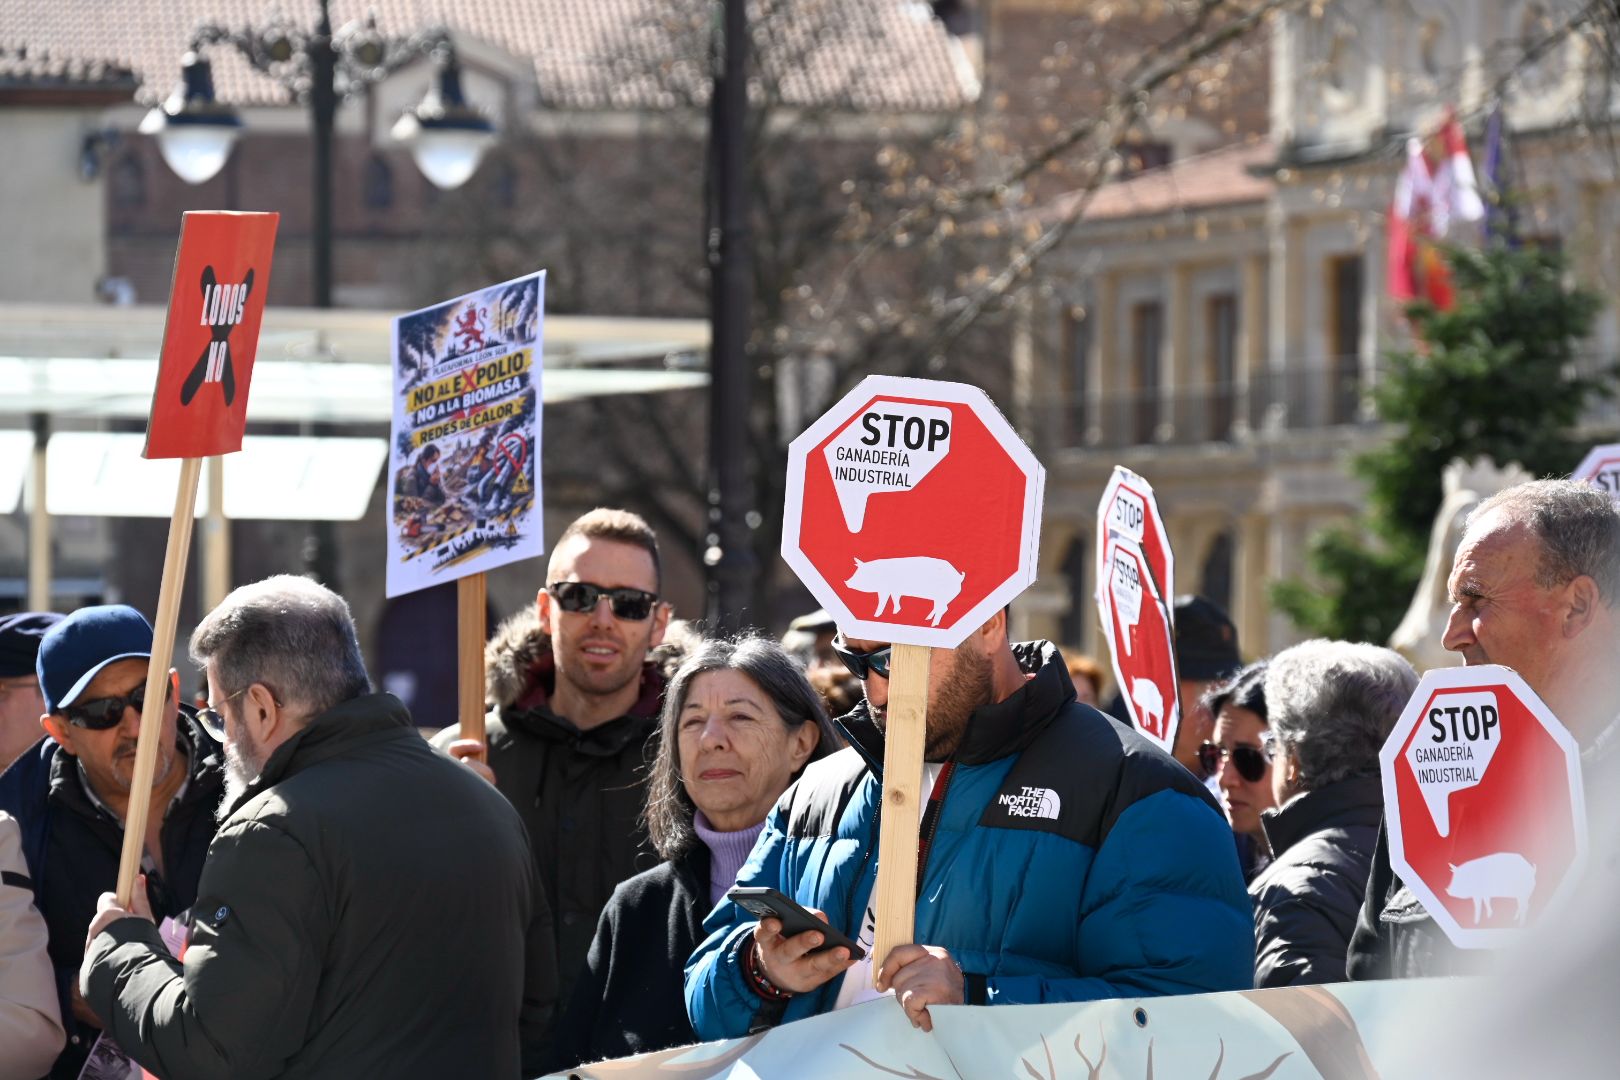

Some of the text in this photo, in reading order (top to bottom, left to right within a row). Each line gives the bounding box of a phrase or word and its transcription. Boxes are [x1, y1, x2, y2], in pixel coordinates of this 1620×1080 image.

[200, 283, 247, 326] LODOS
[204, 341, 227, 383] NO
[413, 352, 524, 407] NO AL EXPOLIO
[417, 376, 521, 424] NO A LA BIOMASA
[463, 408, 470, 418] Y
[420, 403, 513, 444] REDES DE CALOR
[860, 412, 950, 452] STOP
[836, 446, 910, 467] GANADERÍA
[835, 466, 912, 488] INDUSTRIAL
[1596, 471, 1620, 491] ST
[1116, 496, 1143, 531] STOP
[1115, 558, 1139, 592] STOP
[1429, 705, 1498, 743] STOP
[1416, 743, 1474, 763] GANADERÍA
[1418, 767, 1479, 784] INDUSTRIAL
[998, 793, 1042, 808] NORTH
[1021, 786, 1045, 798] THE
[1008, 805, 1038, 818] FACE
